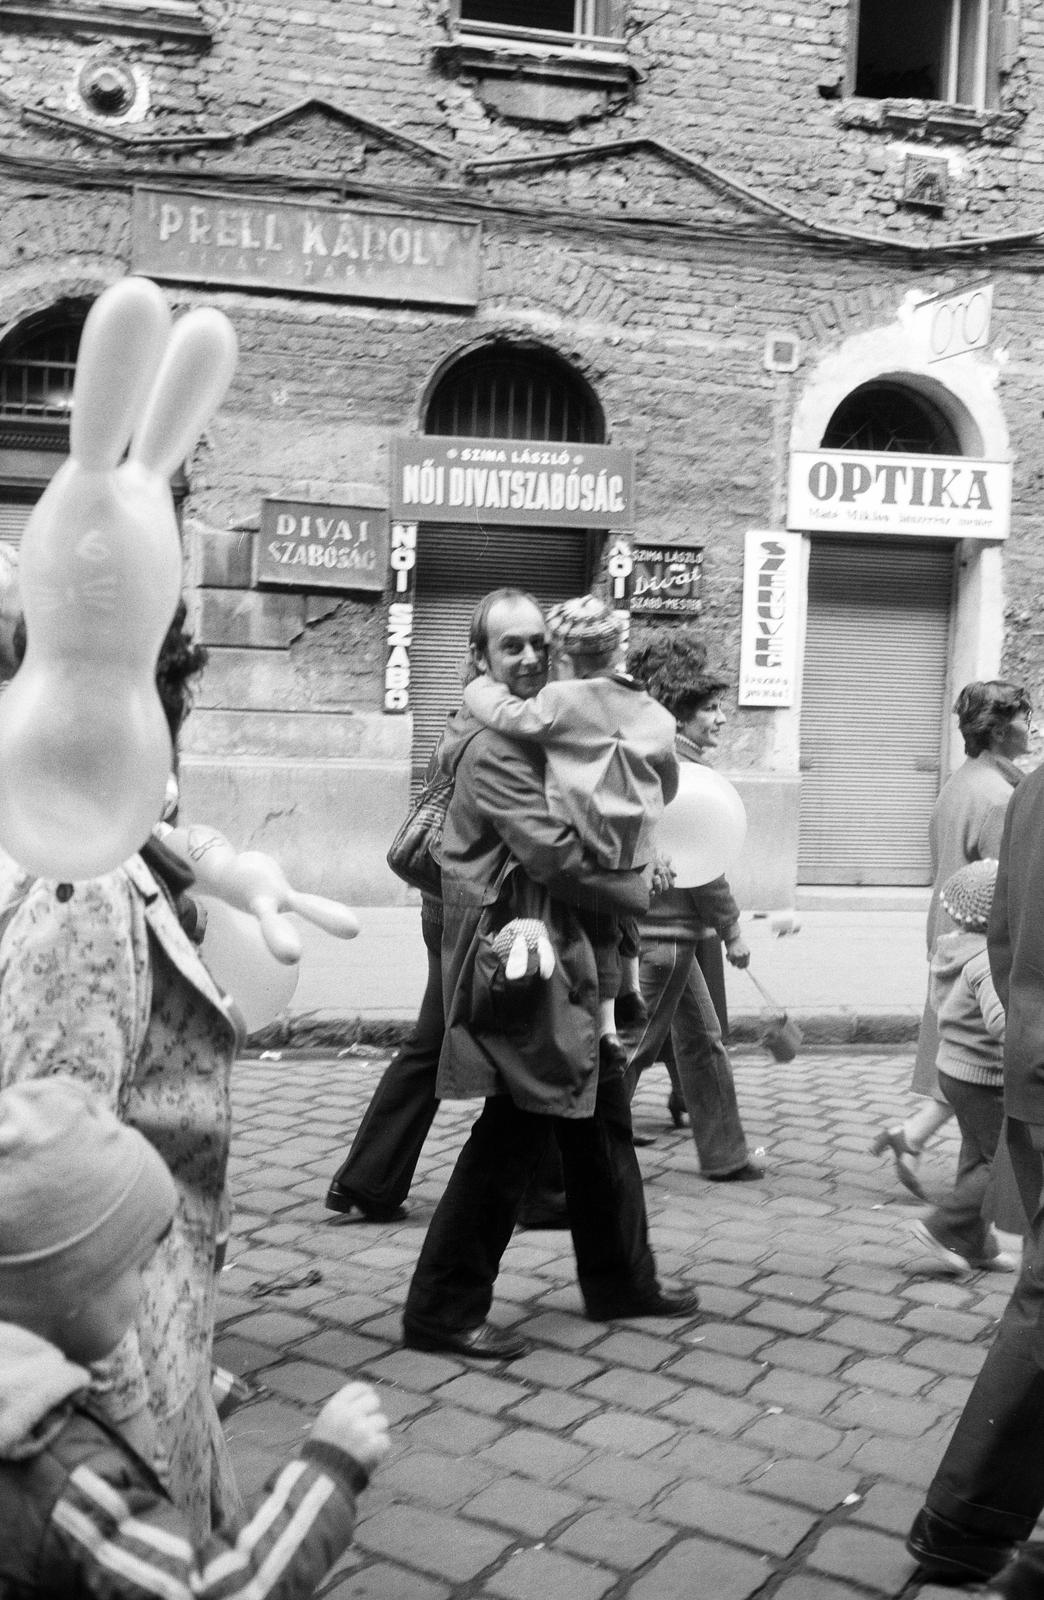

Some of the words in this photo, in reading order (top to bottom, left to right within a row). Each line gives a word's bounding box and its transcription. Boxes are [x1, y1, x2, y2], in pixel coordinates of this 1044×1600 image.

[159, 202, 282, 251] PRELL
[460, 448, 506, 462] SZIMA
[511, 449, 570, 465] LÁSZLÓ
[403, 459, 445, 505] NŐI
[450, 467, 626, 512] DIVATSZABÓSÁG
[808, 461, 993, 510] OPTIKA
